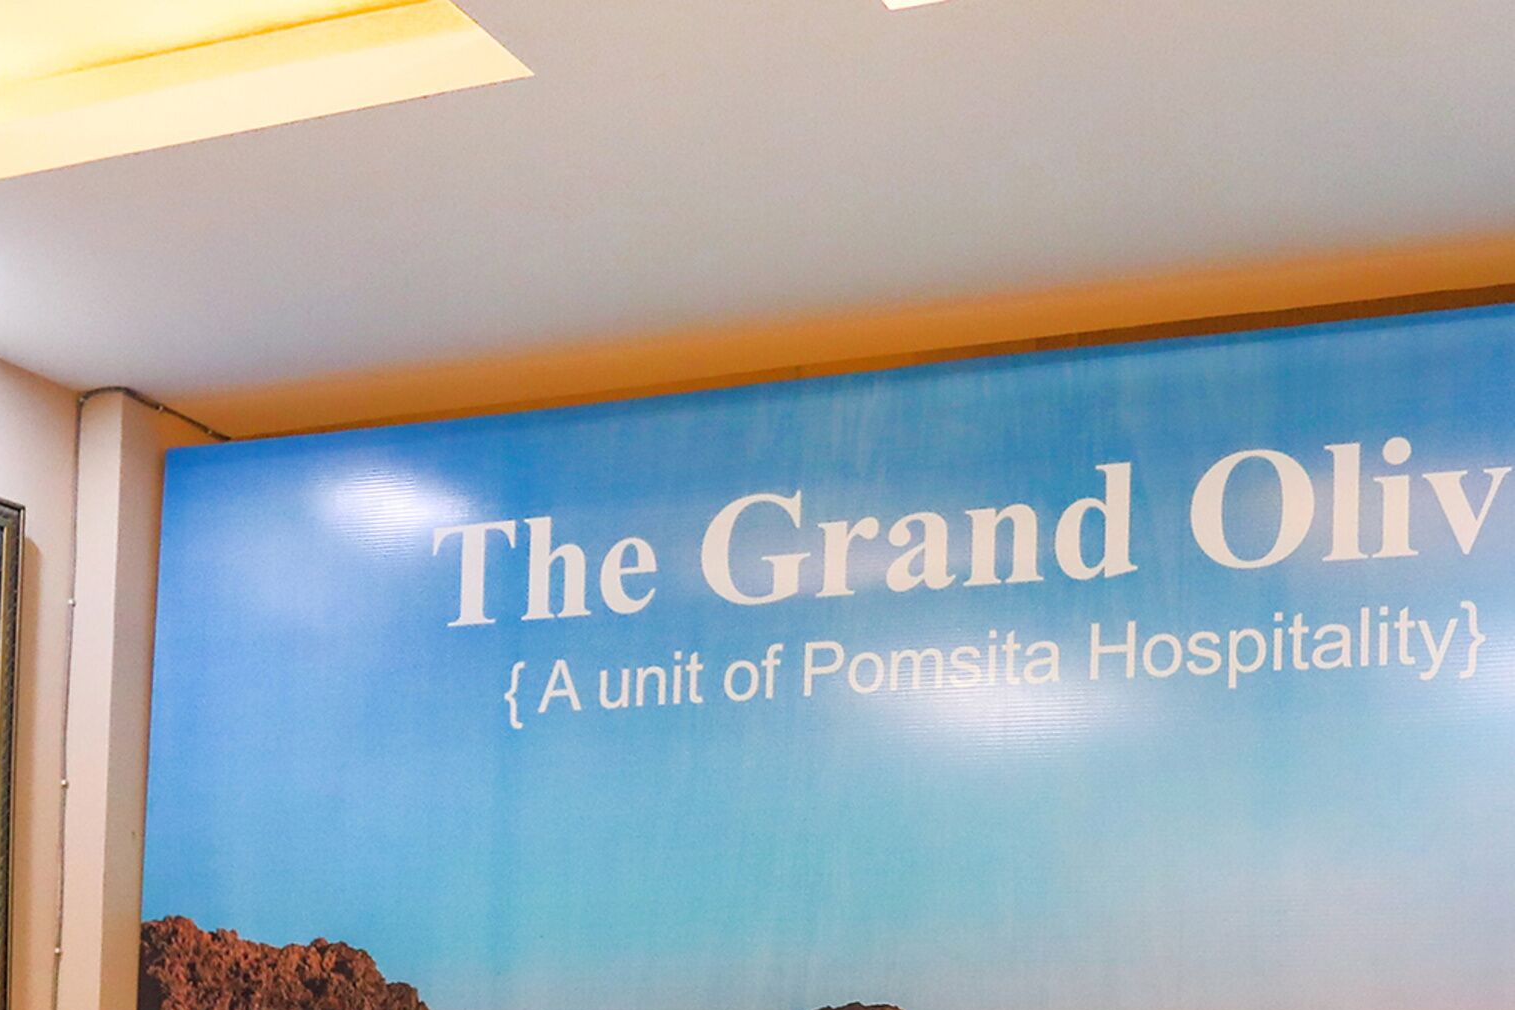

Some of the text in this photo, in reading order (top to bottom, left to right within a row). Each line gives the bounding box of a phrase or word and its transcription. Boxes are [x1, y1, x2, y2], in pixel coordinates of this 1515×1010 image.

[432, 436, 1513, 627] The Grand Oliv
[598, 651, 704, 709] unit
[723, 643, 784, 702] of
[803, 629, 1062, 698] Pomsita
[1088, 600, 1486, 690] Hospitality}
